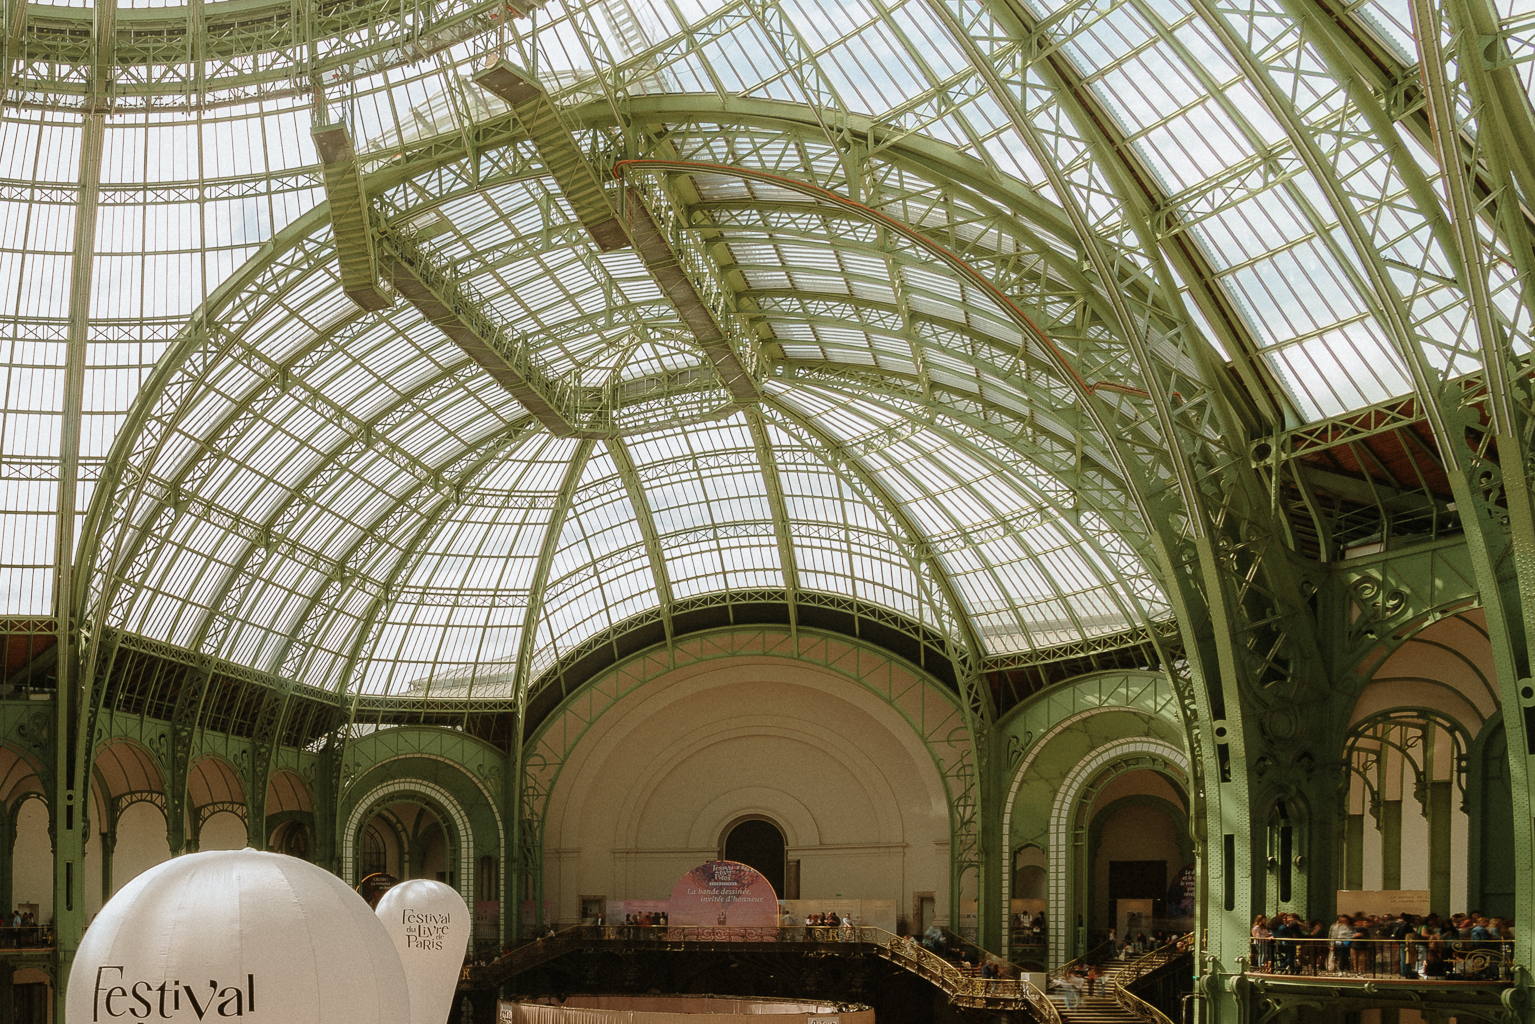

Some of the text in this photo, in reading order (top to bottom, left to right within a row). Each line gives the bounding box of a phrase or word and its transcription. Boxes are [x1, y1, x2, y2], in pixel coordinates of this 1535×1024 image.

[403, 909, 450, 924] Festival
[407, 924, 449, 938] du Livre
[93, 966, 255, 1022] Festival
